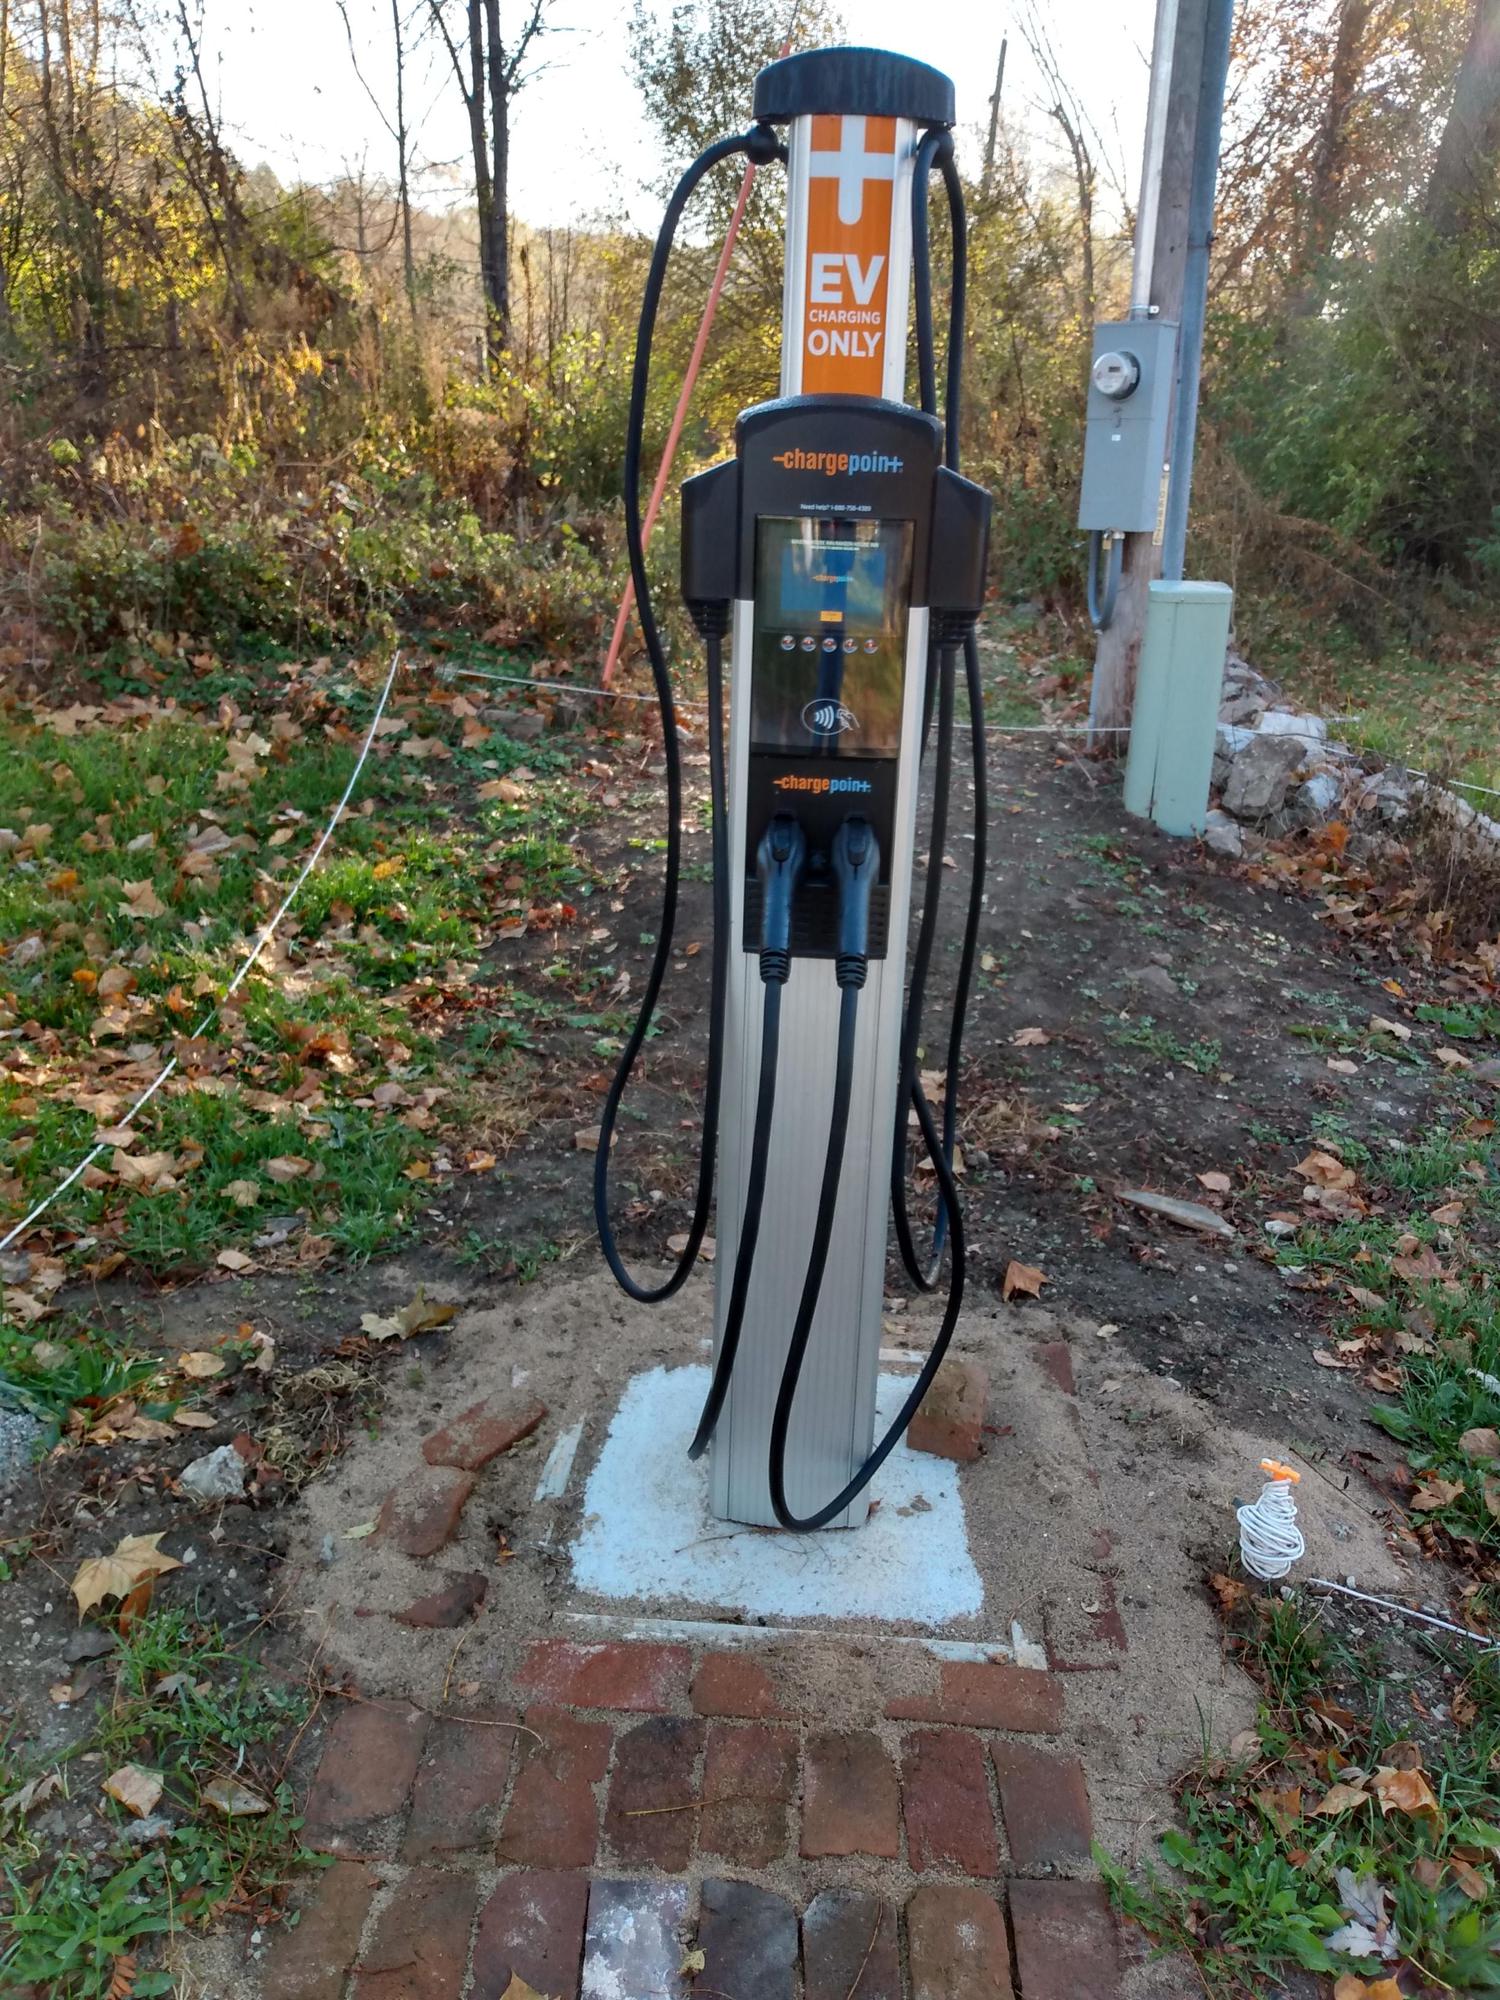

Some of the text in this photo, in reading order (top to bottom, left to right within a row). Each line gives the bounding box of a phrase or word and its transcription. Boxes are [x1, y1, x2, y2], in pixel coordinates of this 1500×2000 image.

[810, 253, 885, 305] EV
[809, 309, 880, 325] CHARGING
[807, 329, 881, 358] ONLY
